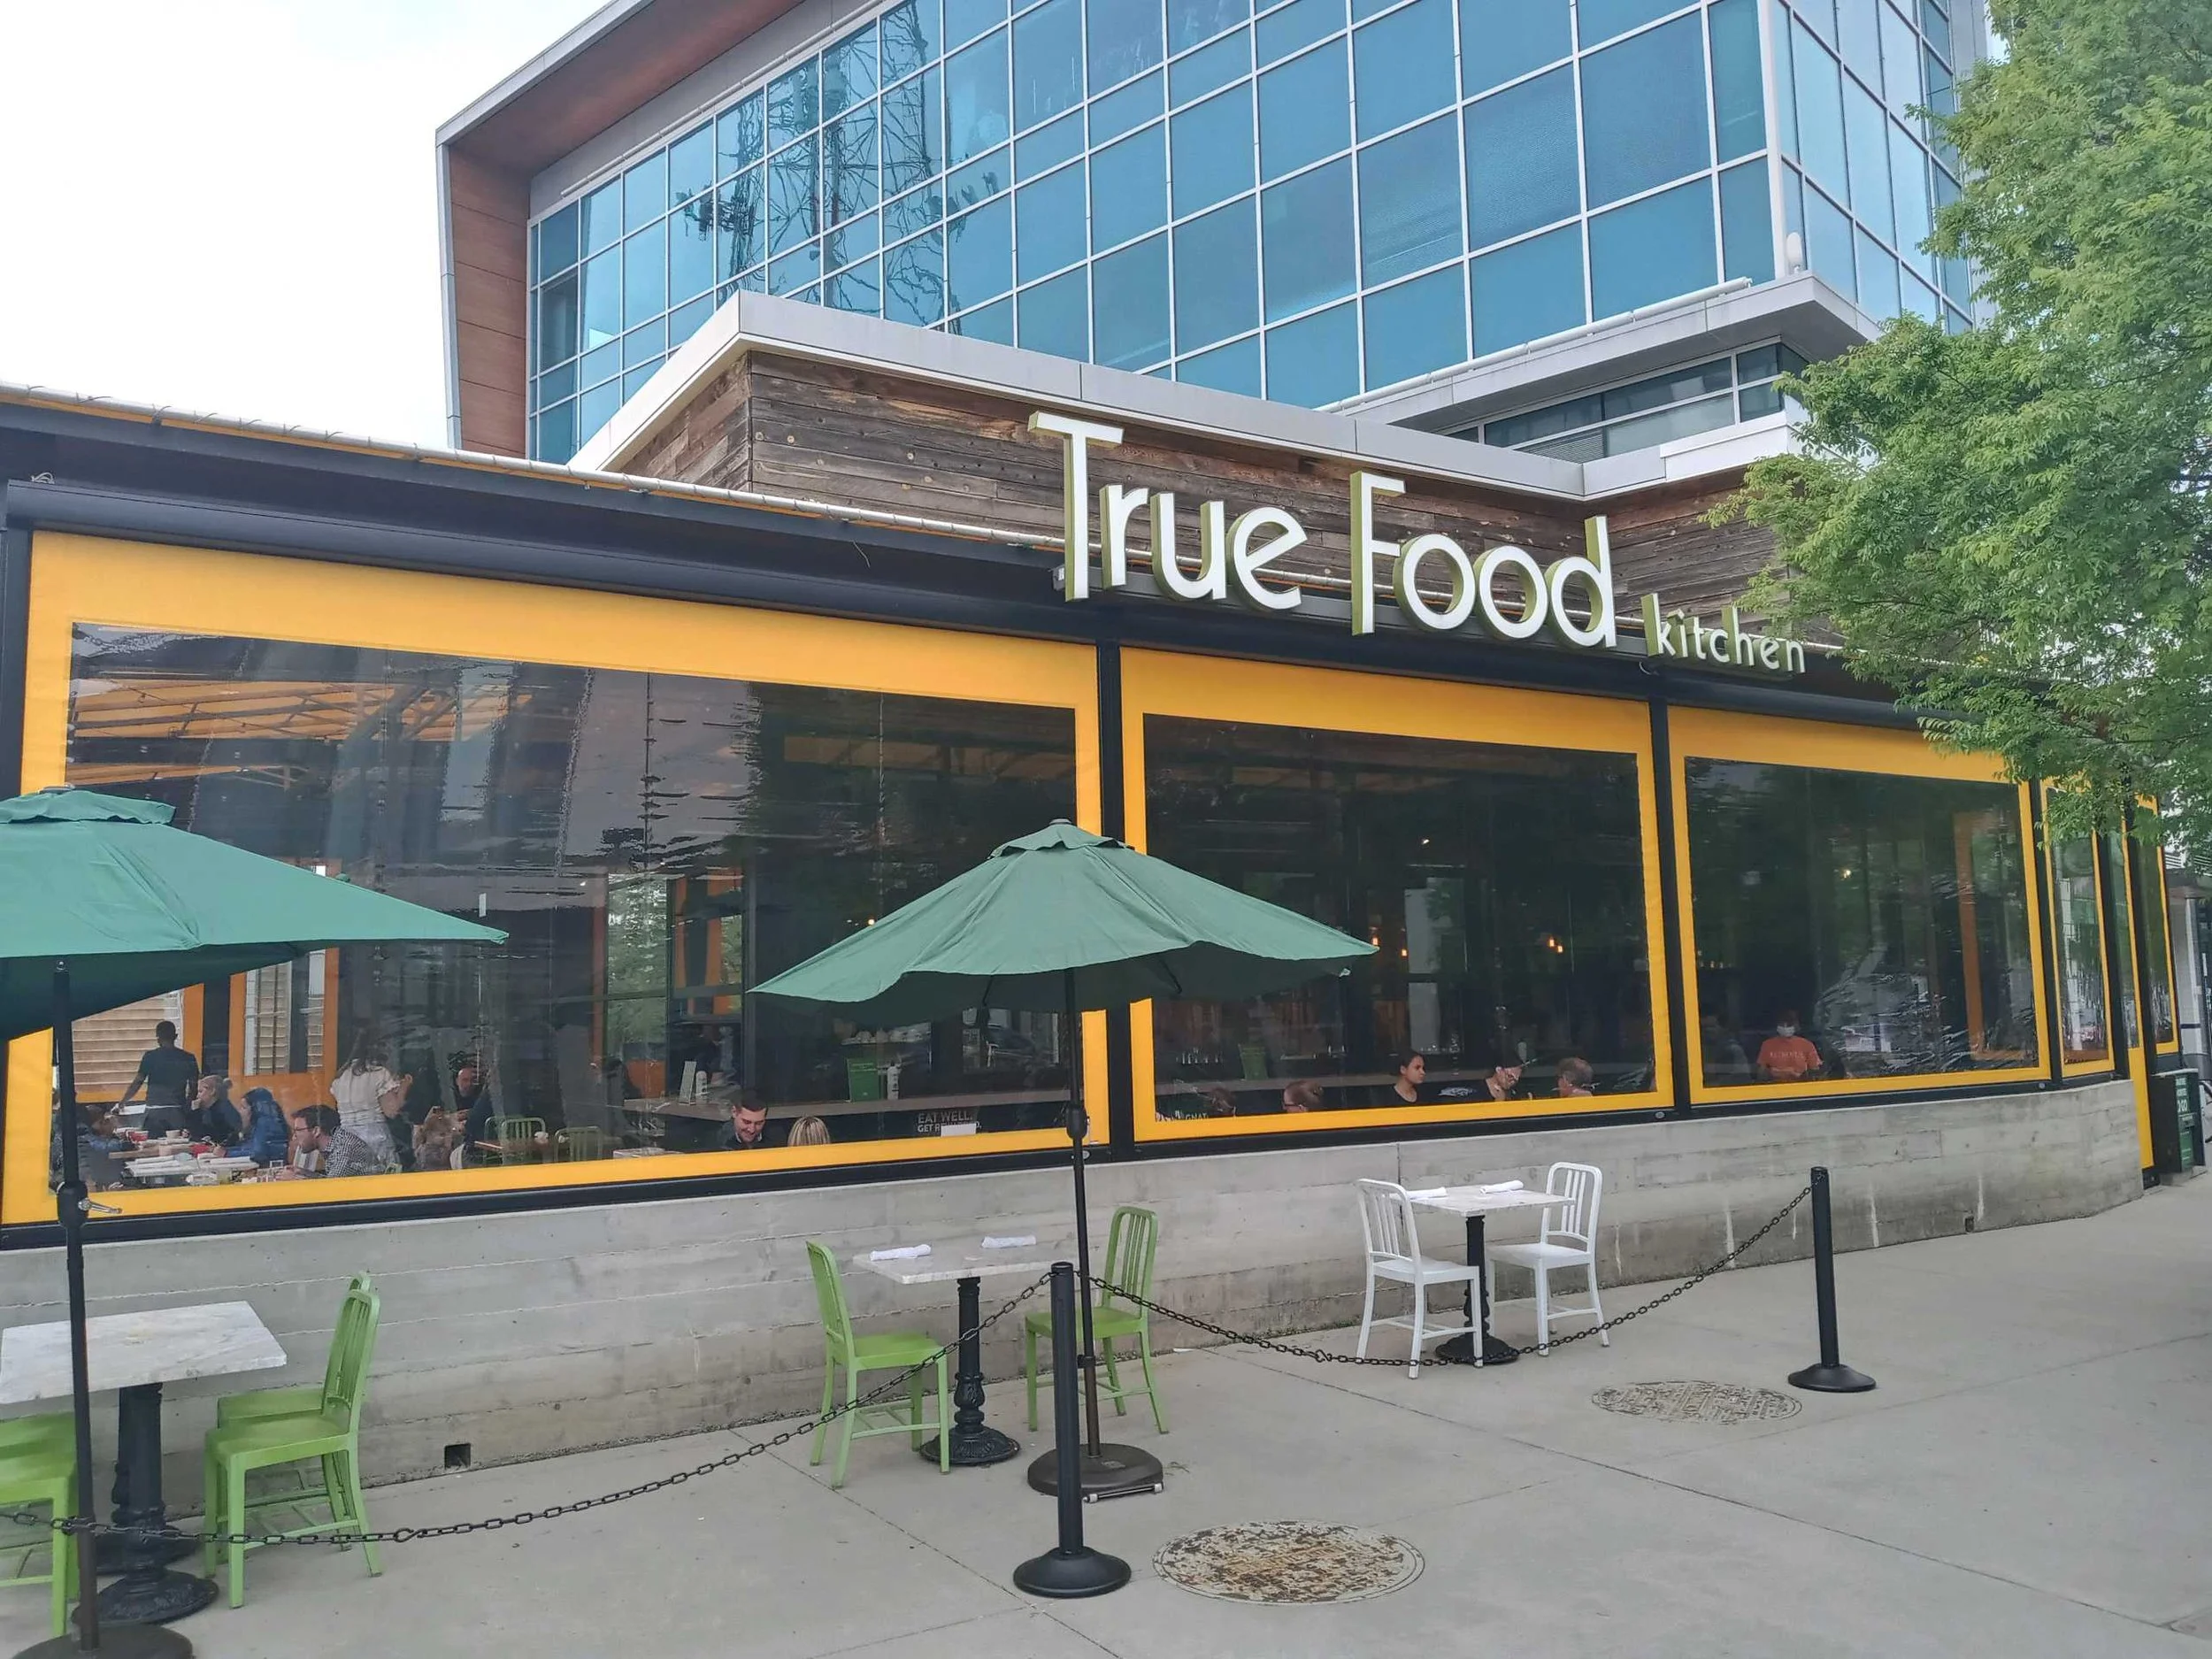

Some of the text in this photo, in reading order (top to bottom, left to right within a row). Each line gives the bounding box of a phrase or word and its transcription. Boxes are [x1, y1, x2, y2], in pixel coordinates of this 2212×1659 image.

[1028, 411, 1806, 673] True Food kitchen
[918, 1110, 973, 1124] EAT WELL.
[918, 1124, 933, 1133] GET
